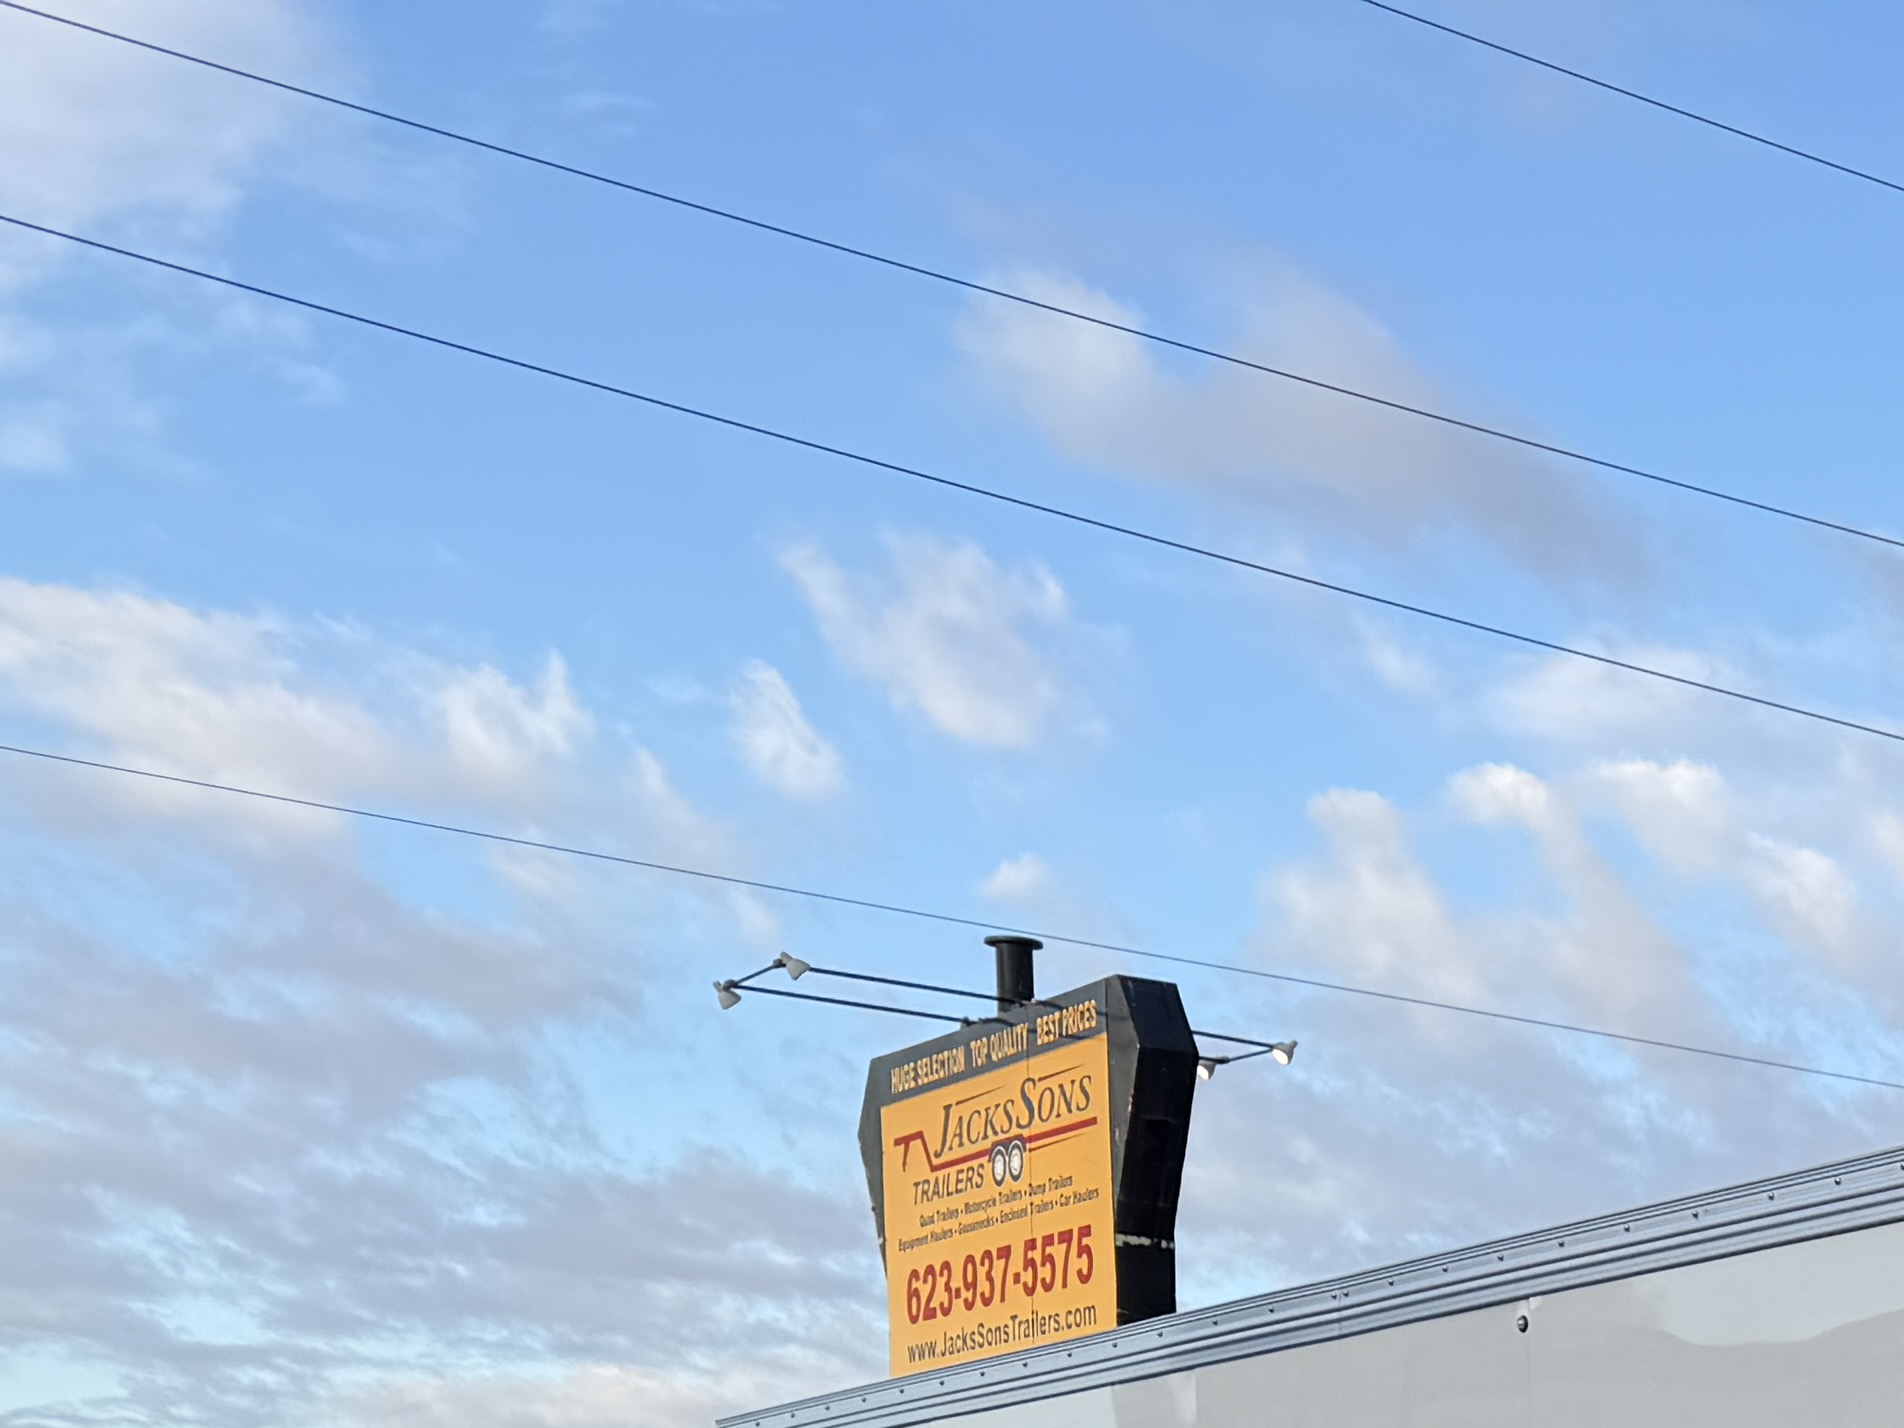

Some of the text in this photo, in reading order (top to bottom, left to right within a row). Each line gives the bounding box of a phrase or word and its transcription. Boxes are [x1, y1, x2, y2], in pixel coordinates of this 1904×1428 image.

[891, 999, 1097, 1094] HUGE SELECTION TOP QUALITY BEST PRICES
[913, 1163, 985, 1206] TRAILERS
[906, 1224, 1094, 1325] 623-937-5575
[907, 1304, 1097, 1363] www.JacksSonsTrailers.com
